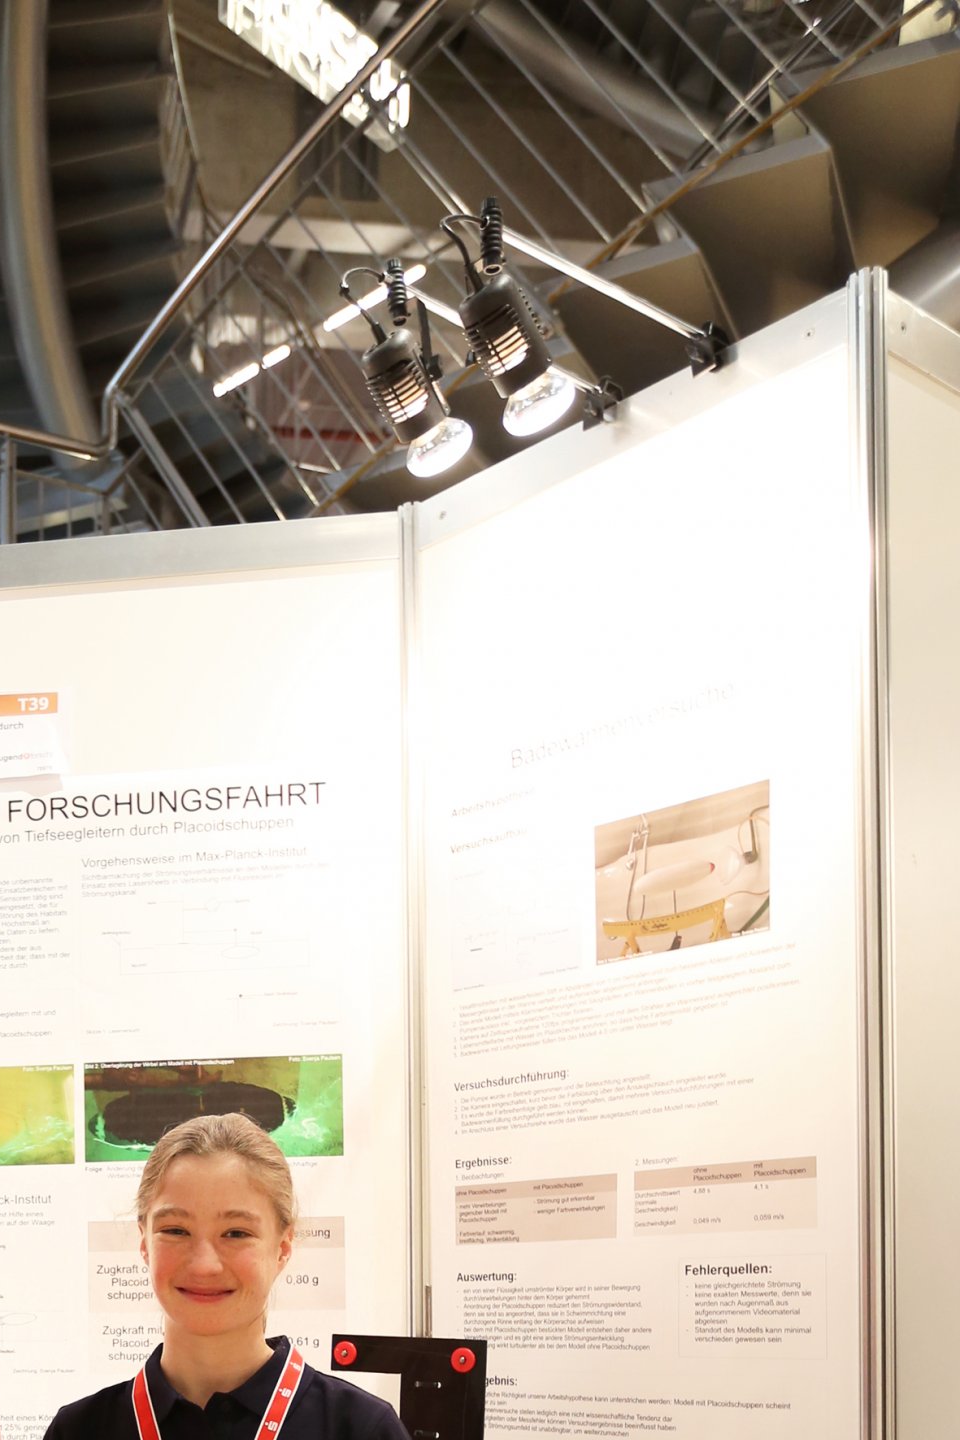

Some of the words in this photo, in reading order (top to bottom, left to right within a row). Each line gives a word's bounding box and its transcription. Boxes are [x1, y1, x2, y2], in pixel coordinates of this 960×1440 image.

[17, 697, 49, 712] T39
[8, 781, 328, 824] FORSCHUNGSFAHRT
[24, 828, 124, 841] Tiefseegleitern
[129, 823, 168, 835] durch
[173, 818, 293, 832] Placoidschuppen
[81, 856, 174, 867] Vorgehensweise
[196, 847, 306, 860] Max-Planck-Institut
[453, 1067, 569, 1092] Versuchsdurchführung:
[455, 1155, 513, 1170] Ergebnisse:
[753, 1168, 806, 1176] Placoidschuppen
[293, 1228, 330, 1240] essung
[96, 1264, 140, 1277] Zugkraft
[685, 1262, 773, 1278] Fehlerquellen:
[286, 1275, 309, 1286] 0,80
[312, 1277, 319, 1287] g
[456, 1272, 517, 1283] Auswertung:
[766, 1280, 801, 1288] Strömung
[736, 1299, 774, 1307] Augenmaß
[102, 1326, 144, 1338] Zugkraft
[112, 1339, 153, 1348] Placoid-
[313, 1339, 320, 1349] g
[108, 1353, 150, 1364] schuppe
[485, 1376, 518, 1388] gebnis:
